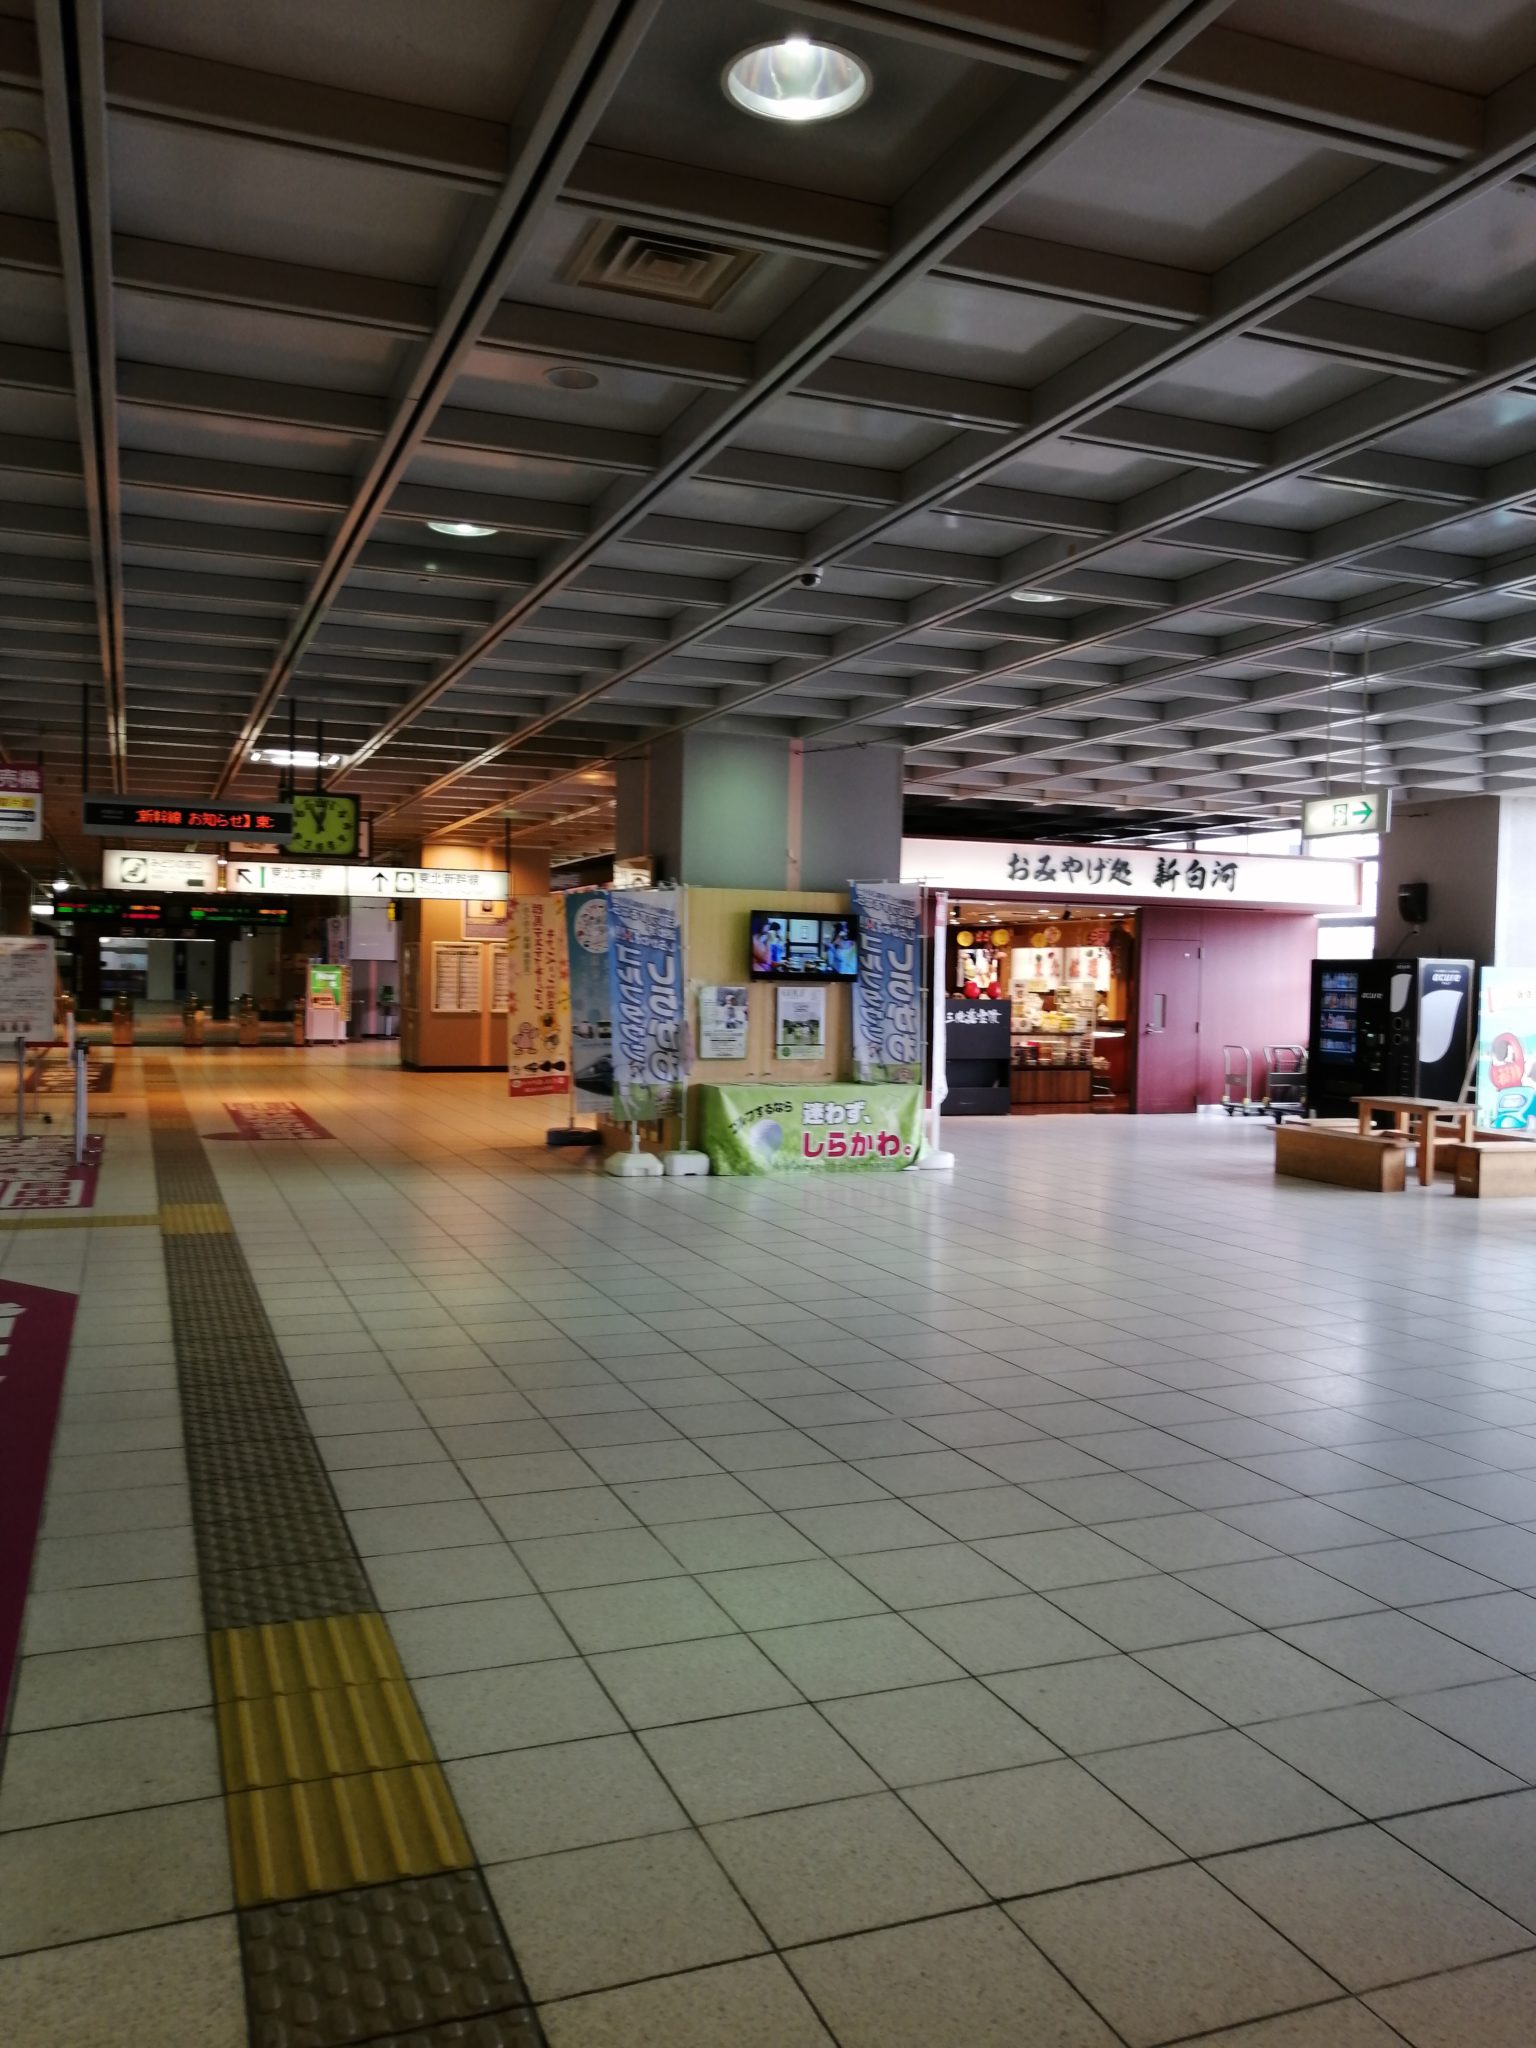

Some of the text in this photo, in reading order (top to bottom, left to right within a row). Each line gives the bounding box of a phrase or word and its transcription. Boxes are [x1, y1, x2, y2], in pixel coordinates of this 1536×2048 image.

[1007, 853, 1239, 892] おみやげ処 新白河
[802, 1101, 872, 1126] 迷わず、
[803, 1130, 912, 1158] しらかわ。
